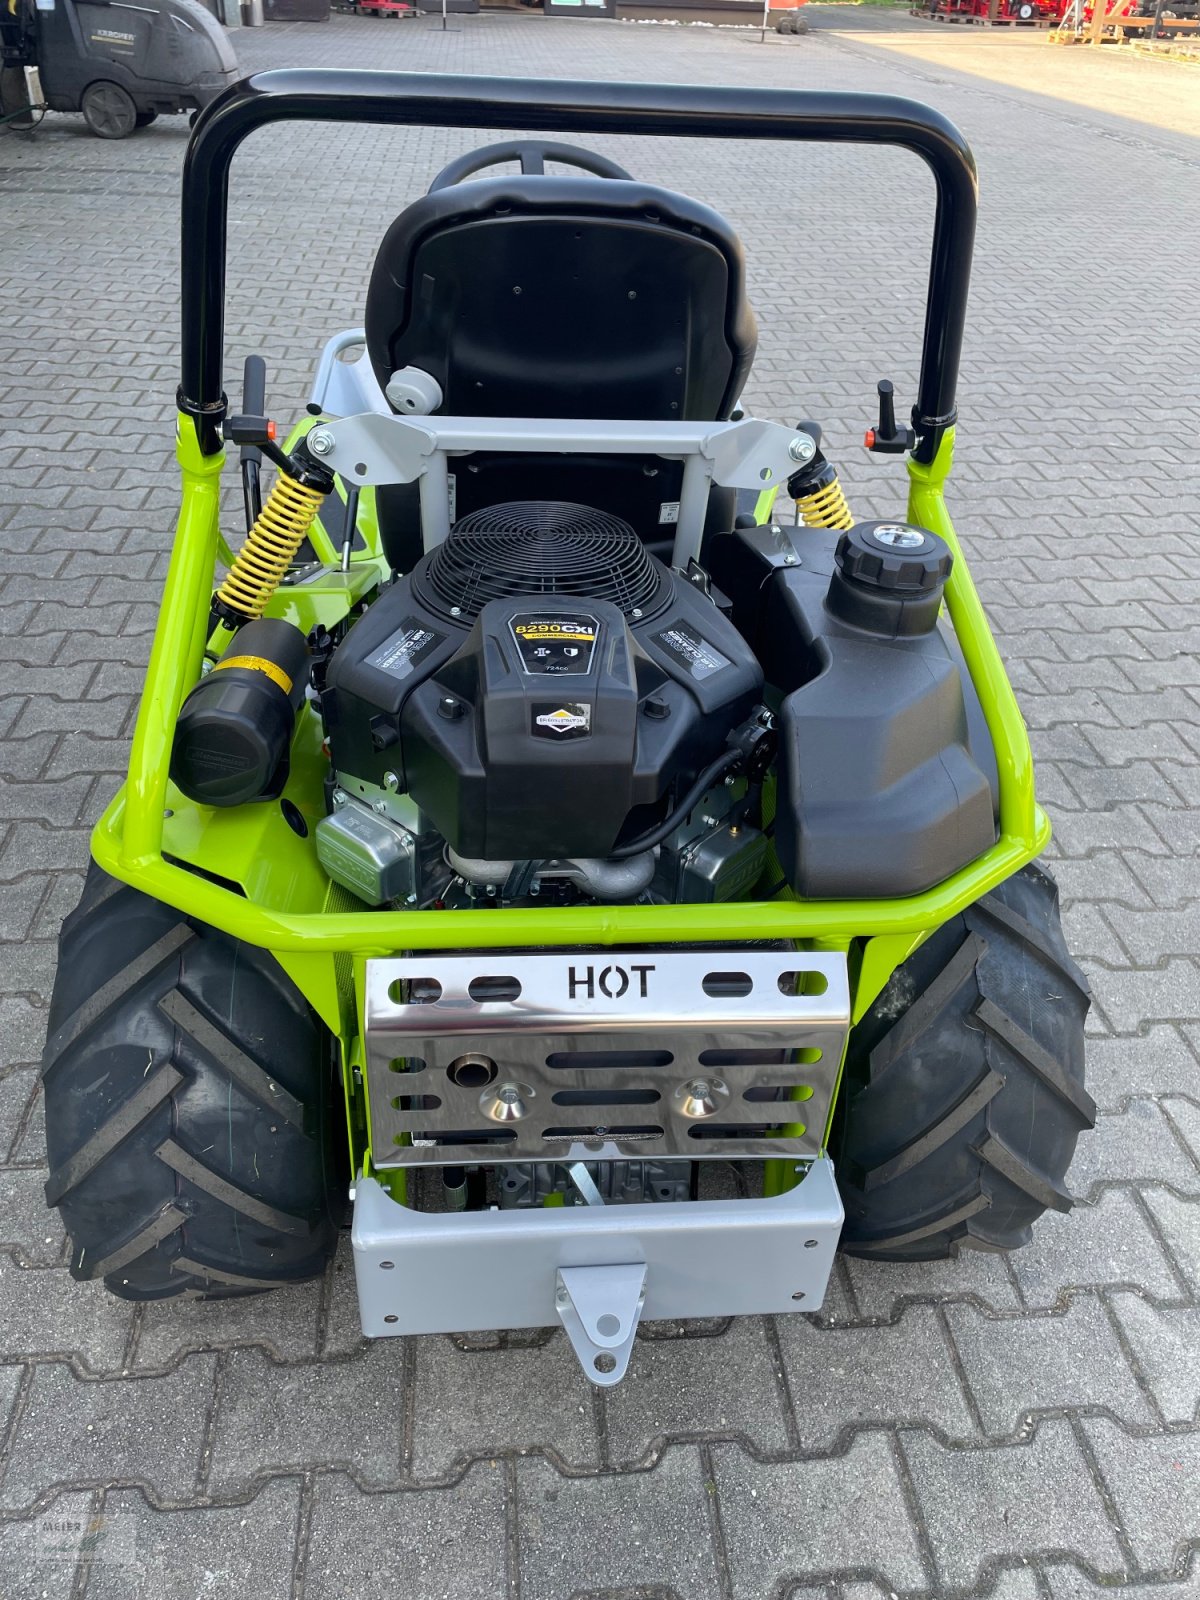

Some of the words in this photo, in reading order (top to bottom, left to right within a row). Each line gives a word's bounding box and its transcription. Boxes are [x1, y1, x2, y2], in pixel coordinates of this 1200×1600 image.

[411, 629, 425, 641] AIR
[667, 630, 702, 657] CLEANER
[380, 640, 414, 668] CLEANER
[700, 658, 717, 668] AIR
[568, 965, 656, 999] HOT
